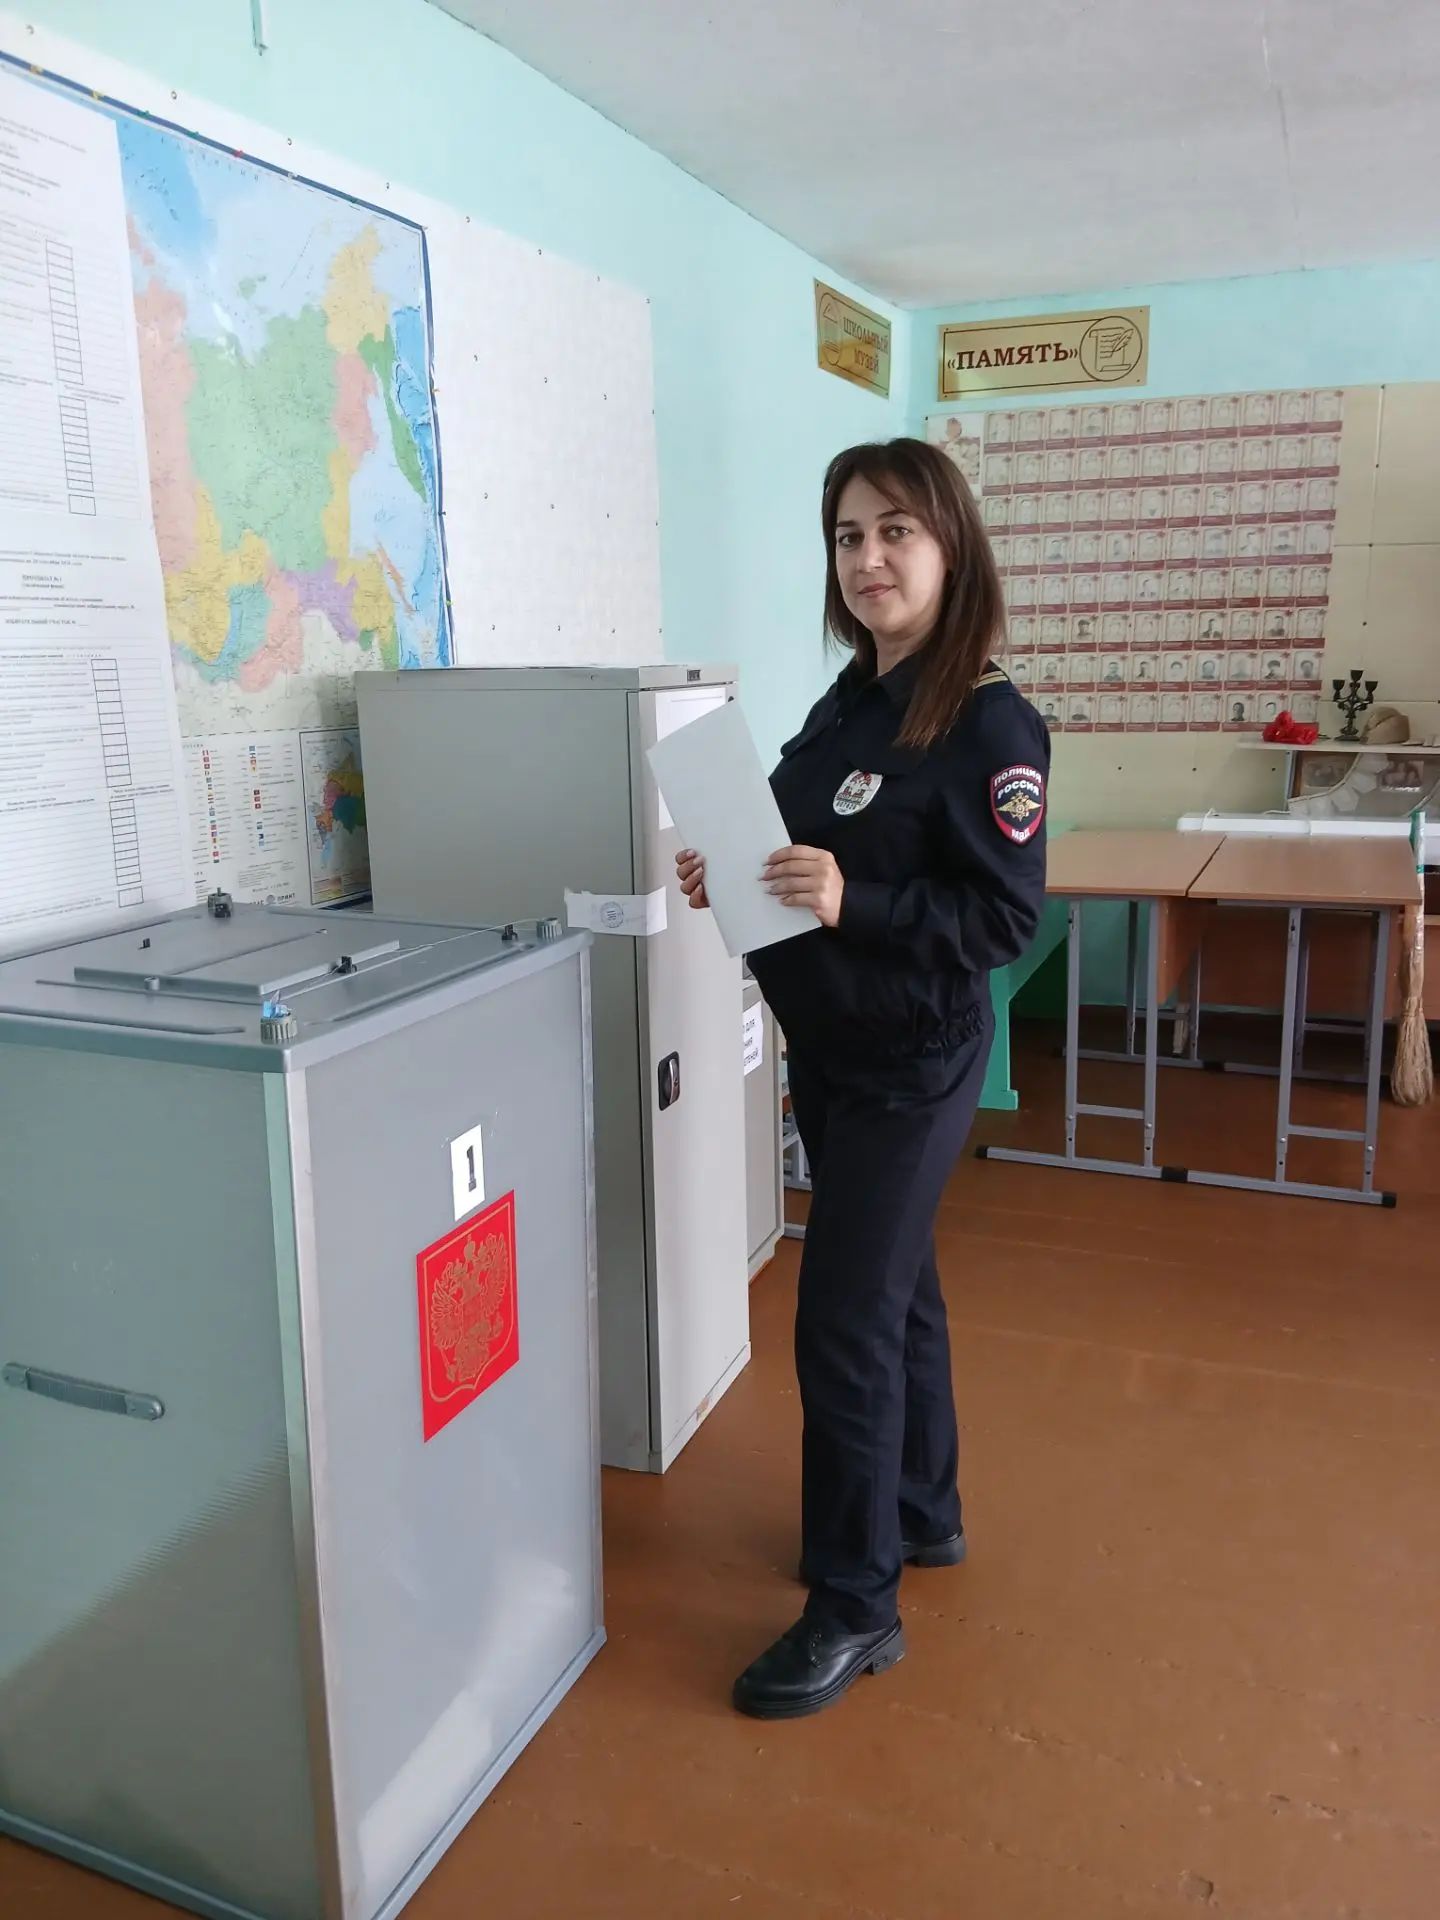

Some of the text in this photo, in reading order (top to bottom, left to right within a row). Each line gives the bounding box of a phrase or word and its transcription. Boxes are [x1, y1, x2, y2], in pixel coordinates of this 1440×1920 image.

[842, 316, 889, 355] ШКОЛЬНЫЙ
[854, 348, 880, 374] МУЗЕЙ
[947, 342, 1078, 371] «ПАМЯТЬ»
[994, 767, 1042, 787] ПОЛИЦИЯ
[997, 780, 1040, 800] РОССИЯ
[1011, 827, 1031, 842] МВД
[466, 1144, 478, 1193] 1
